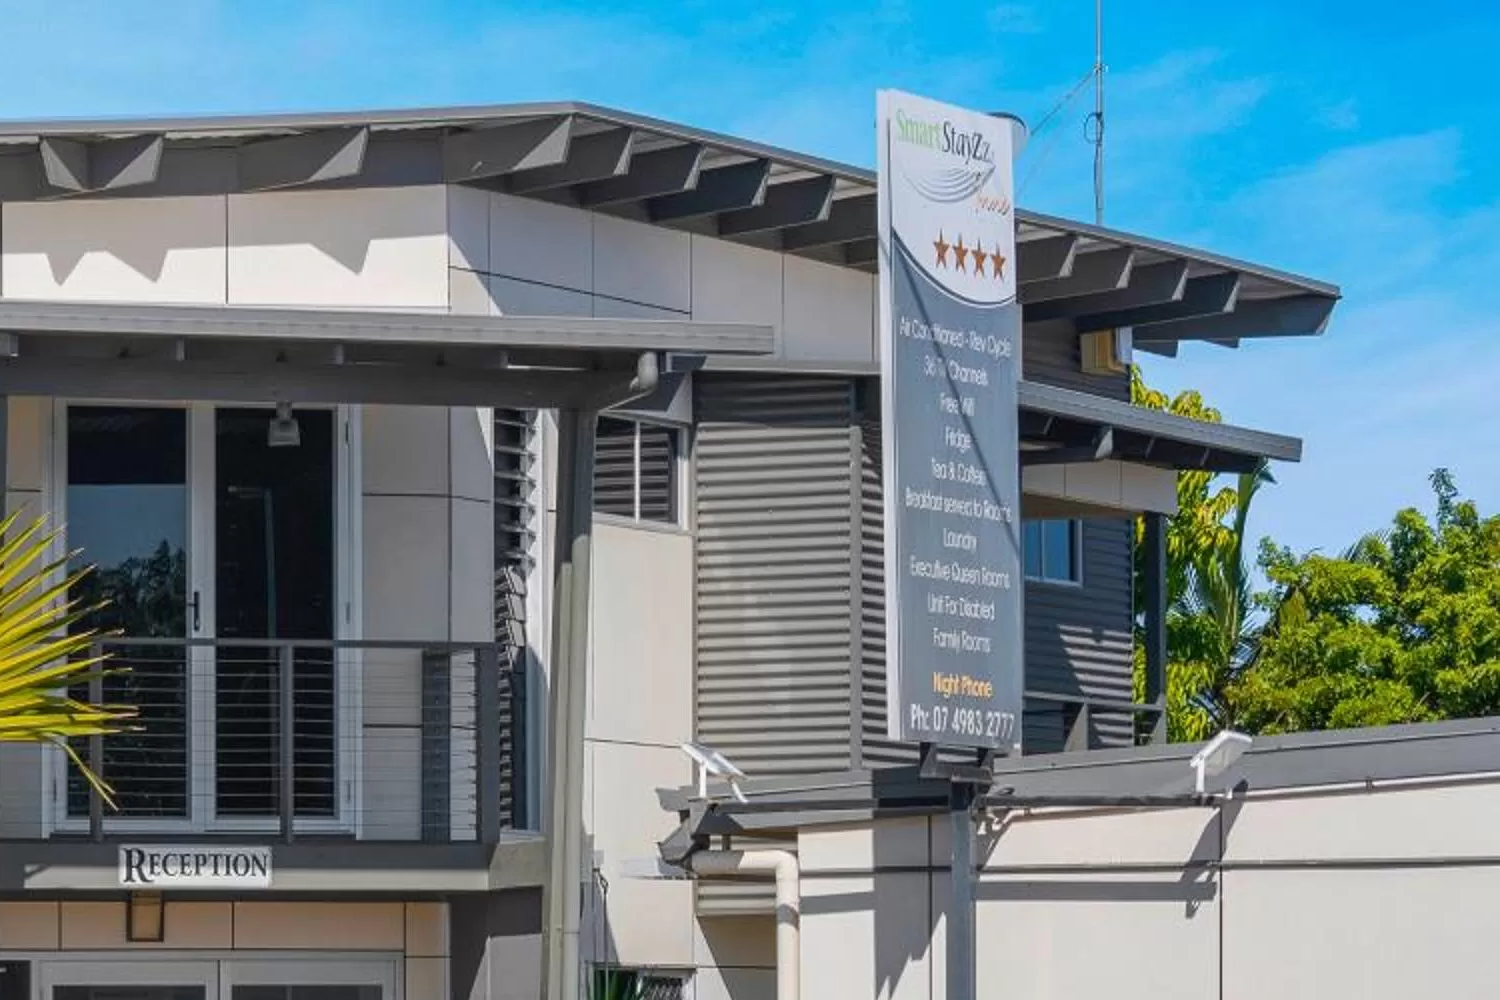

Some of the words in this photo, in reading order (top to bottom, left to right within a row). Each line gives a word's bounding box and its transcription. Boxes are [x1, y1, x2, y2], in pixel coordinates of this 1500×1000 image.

[943, 527, 977, 554] Laundry
[932, 671, 960, 698] Night
[961, 675, 993, 698] Phone
[933, 705, 948, 732] 07
[952, 707, 983, 736] 4983
[986, 710, 1015, 739] 2777
[123, 848, 267, 883] RECEPTION
